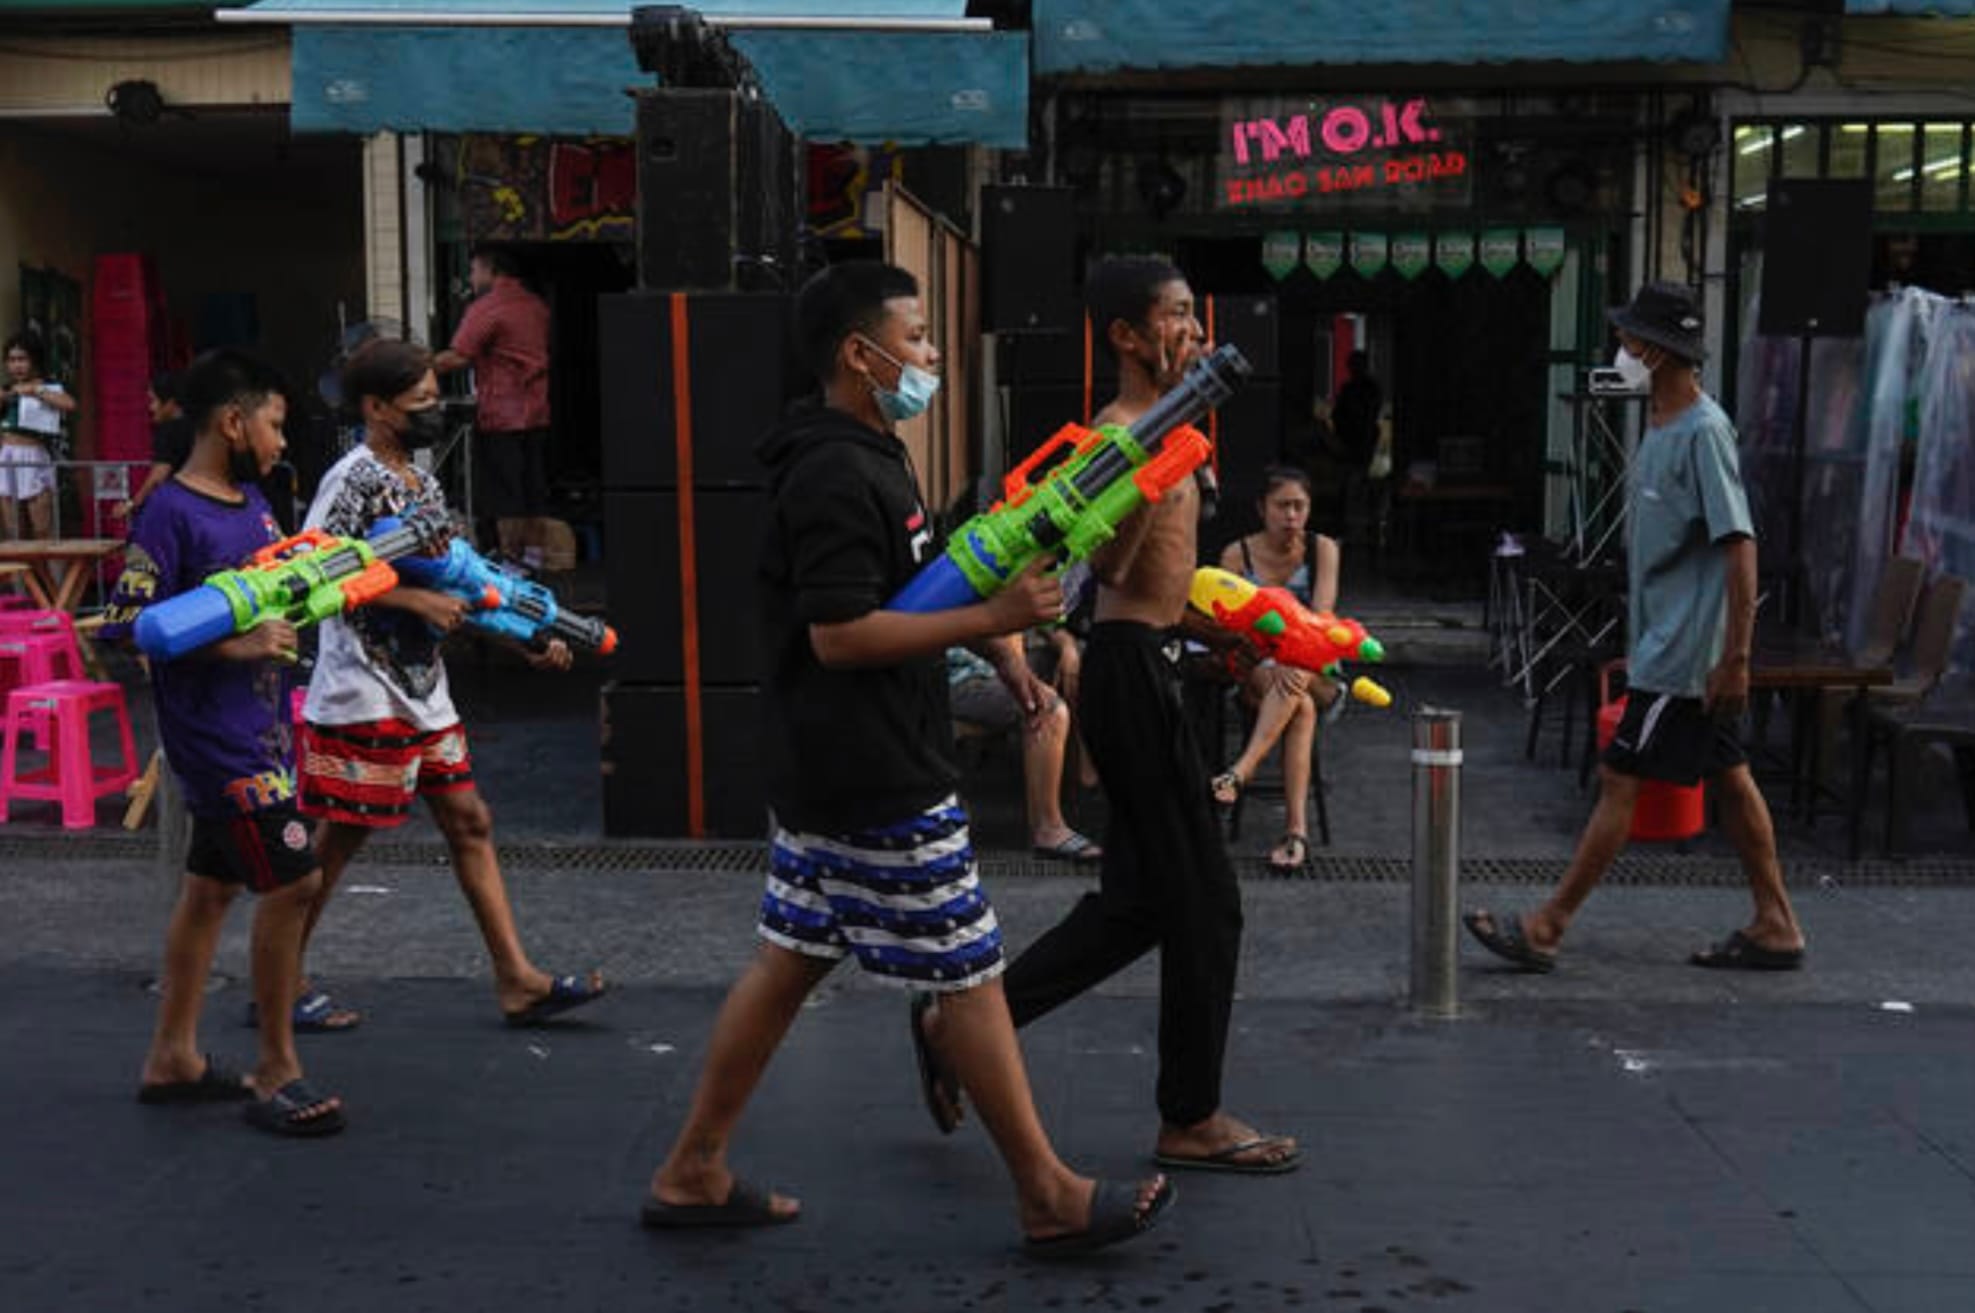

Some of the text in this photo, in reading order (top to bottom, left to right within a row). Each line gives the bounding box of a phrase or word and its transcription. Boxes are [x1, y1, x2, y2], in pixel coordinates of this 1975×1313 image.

[1232, 96, 1442, 166] I'M O.K.
[1316, 163, 1376, 194] SAN
[1383, 151, 1467, 185] ROAD
